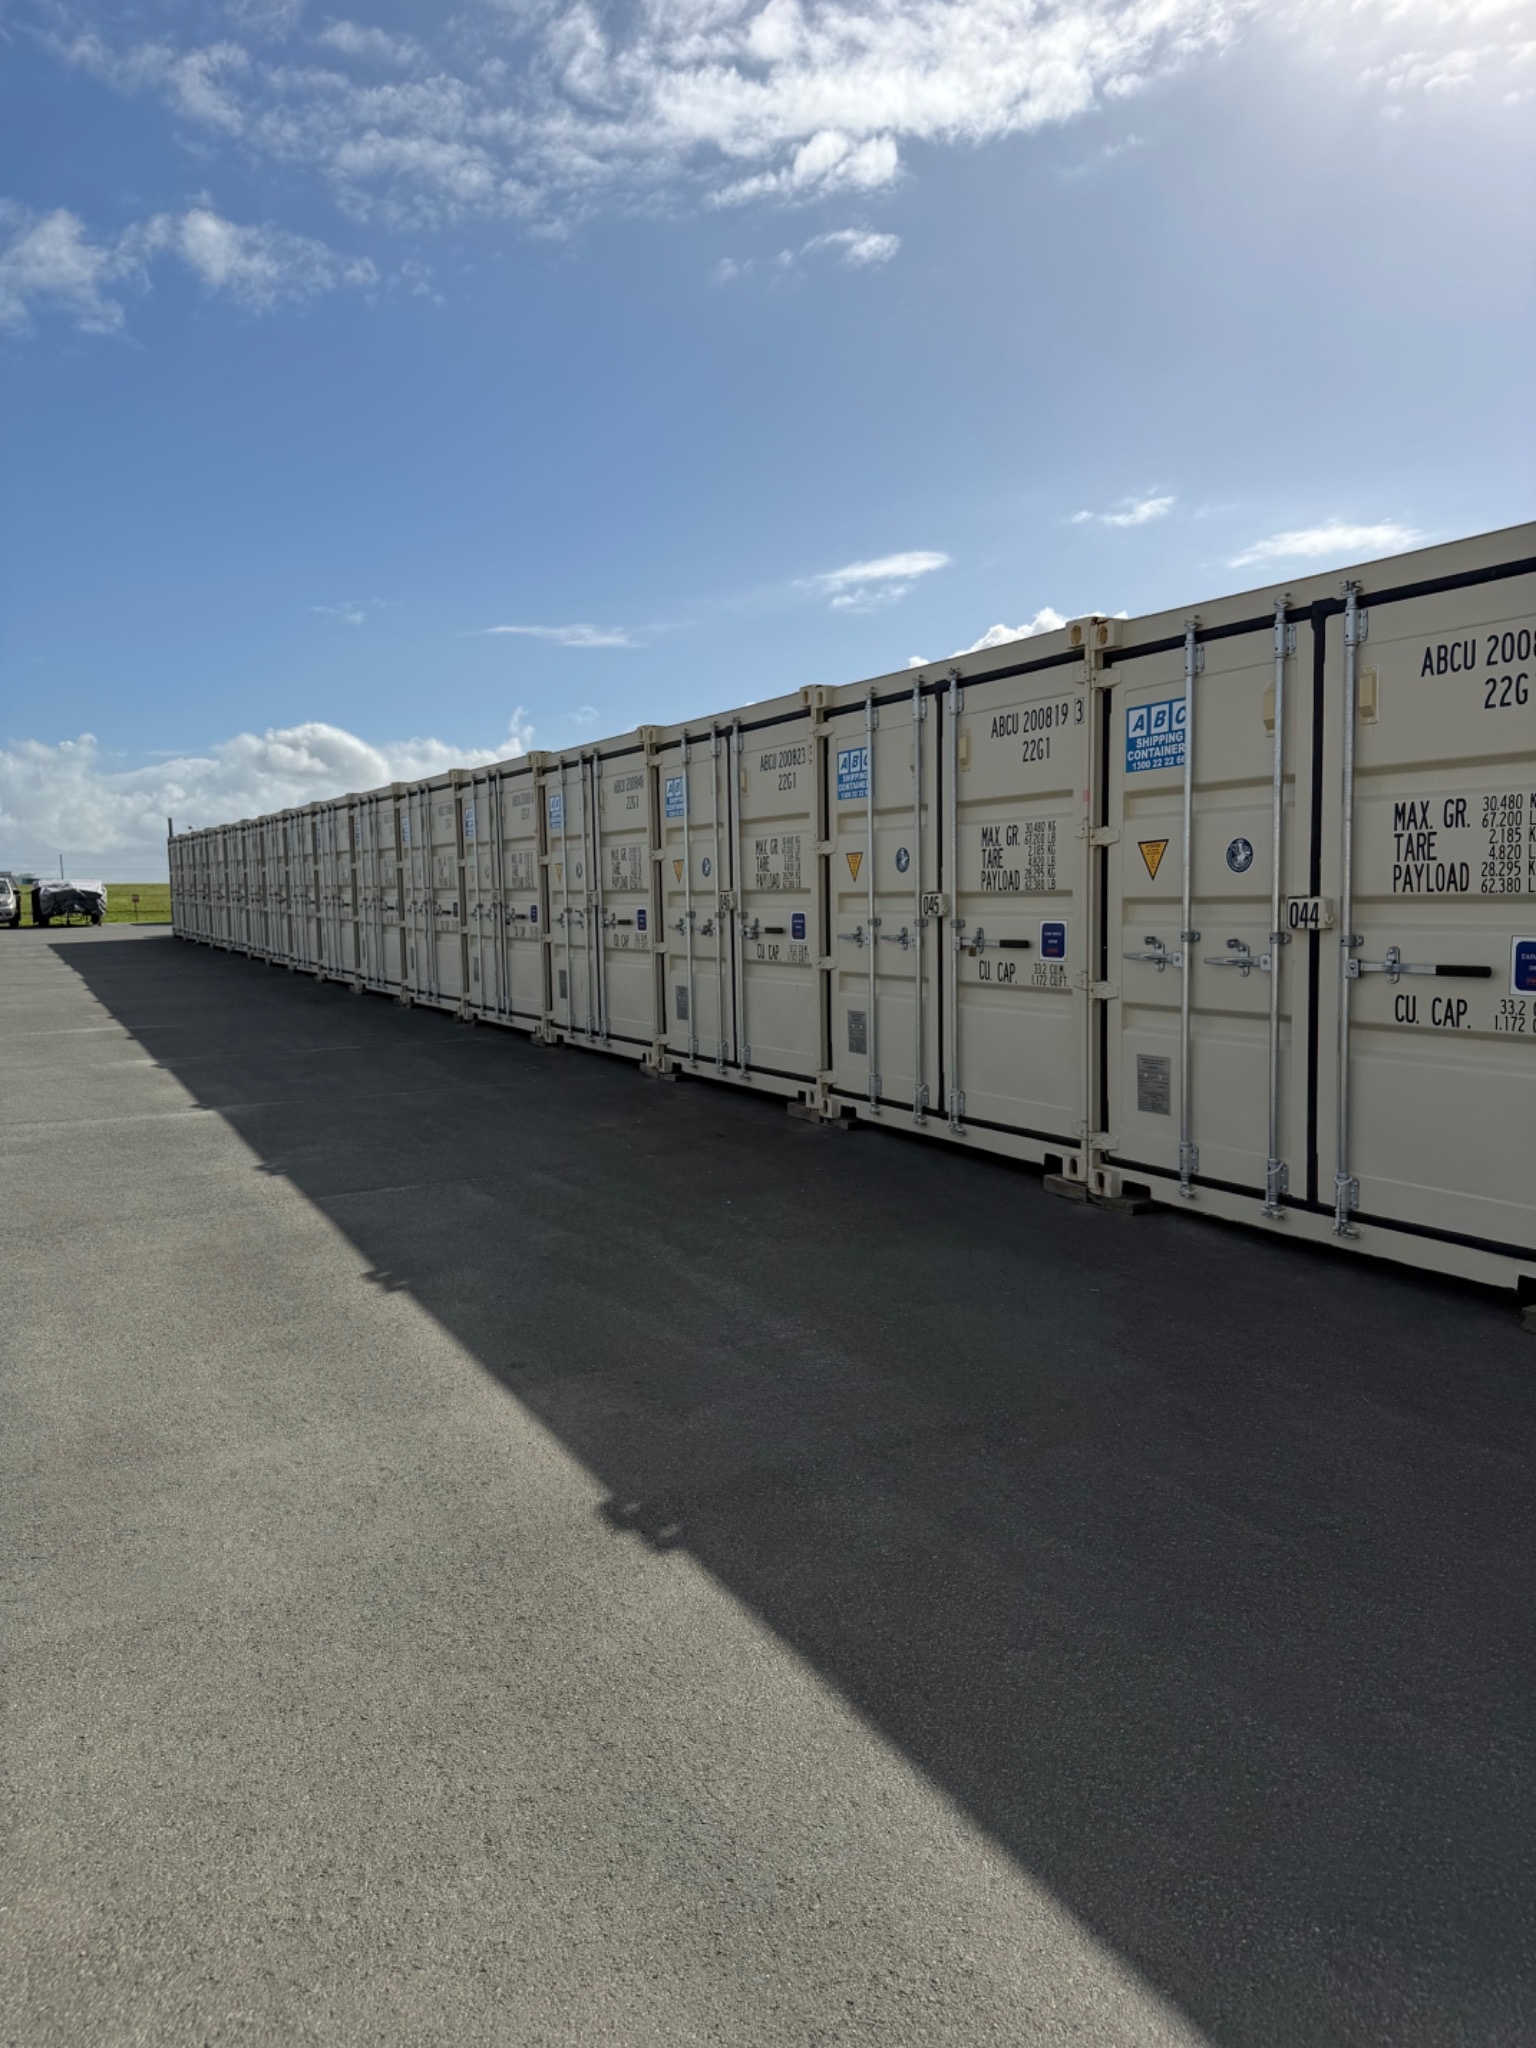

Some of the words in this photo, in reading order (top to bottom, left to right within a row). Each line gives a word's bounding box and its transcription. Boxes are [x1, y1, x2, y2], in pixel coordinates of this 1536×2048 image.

[1421, 639, 1477, 677] ABCU
[1484, 673, 1536, 709] 22G
[991, 712, 1019, 738] ABCU
[1023, 702, 1069, 733] 200819
[1076, 700, 1083, 723] 3
[1132, 706, 1186, 732] ABC
[1022, 736, 1050, 762] 22G1
[1136, 731, 1183, 749] SHIPPING
[1132, 759, 1151, 771] 1300
[1153, 758, 1163, 768] 22
[1164, 756, 1175, 766] 22
[1482, 794, 1523, 812] 30.480
[1393, 800, 1434, 831] MAX.
[1443, 798, 1471, 828] GR.
[1393, 831, 1437, 862] TARE
[1488, 844, 1522, 861] 4.820
[981, 848, 1003, 868] TARE
[1393, 862, 1470, 893] PAYLOAD
[1481, 860, 1521, 878] 28.295
[981, 870, 1020, 891] PAYLOAD
[1481, 876, 1521, 894] 62.380
[924, 896, 940, 914] 045
[1289, 902, 1320, 929] 044
[997, 962, 1018, 984] CAP.
[1394, 994, 1419, 1024] CU.
[1431, 997, 1471, 1029] CAP.
[1500, 998, 1526, 1016] 33.2
[1494, 1014, 1525, 1033] 1.172
